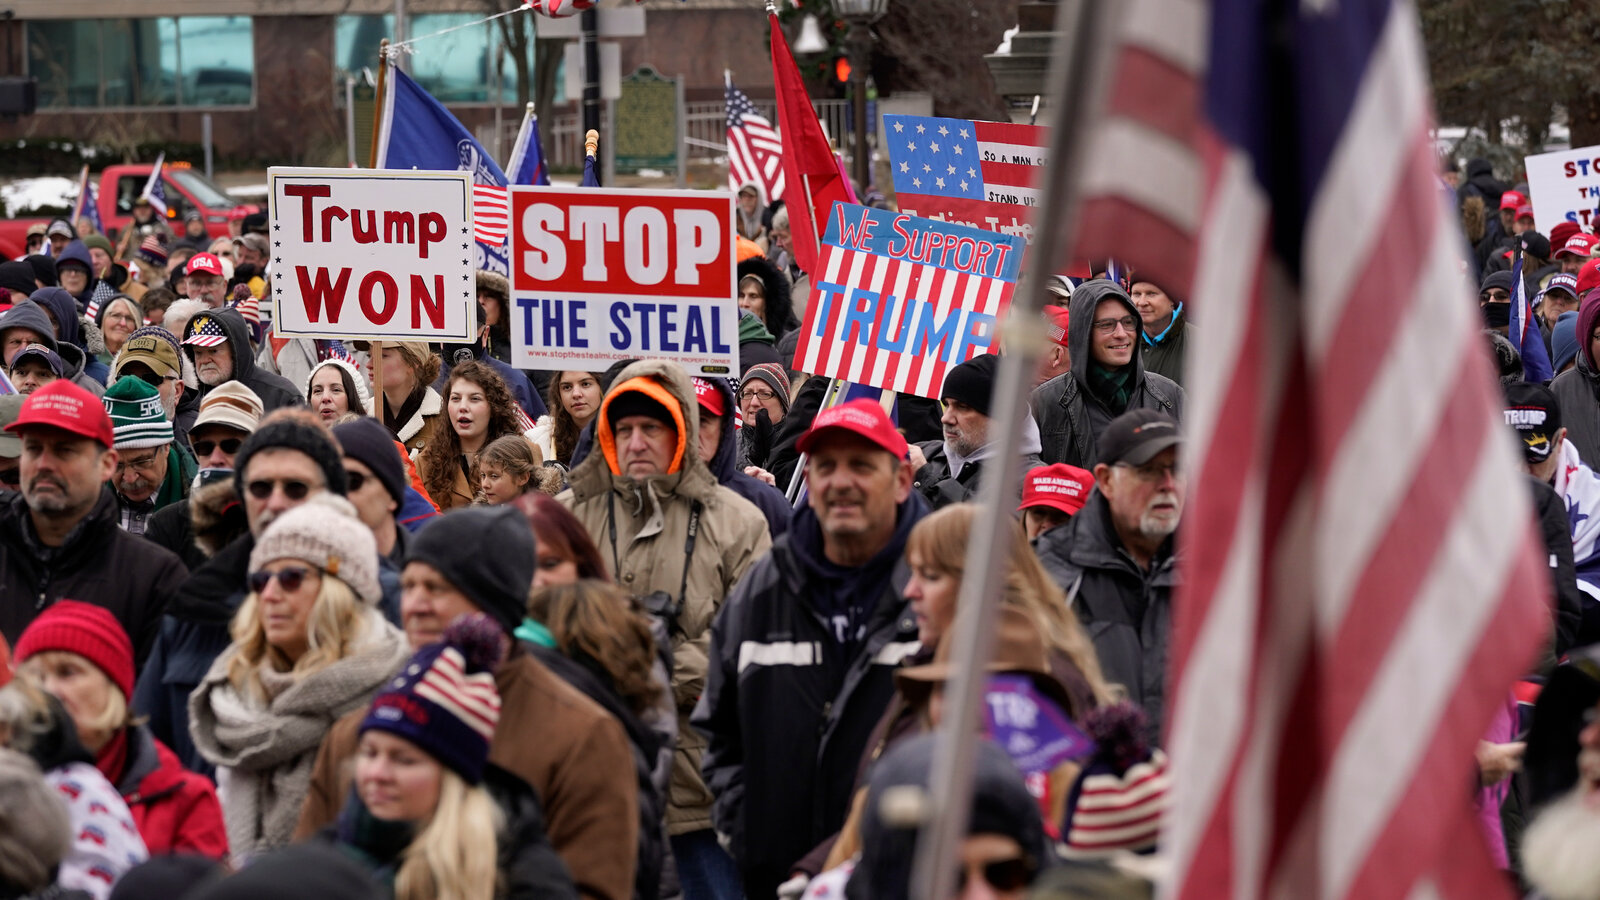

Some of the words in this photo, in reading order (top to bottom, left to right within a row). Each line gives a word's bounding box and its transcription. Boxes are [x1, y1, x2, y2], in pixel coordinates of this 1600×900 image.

[984, 150, 996, 161] SO
[1001, 155, 1008, 163] A
[1012, 155, 1031, 166] MAN
[988, 191, 1019, 205] STAND
[1023, 196, 1036, 208] UP
[284, 184, 447, 259] Trump
[522, 203, 721, 286] STOP
[836, 203, 879, 252] WE
[888, 214, 1013, 278] SUPPORT
[192, 256, 214, 269] USA
[295, 265, 445, 329] WON
[516, 298, 589, 348] THE
[609, 301, 731, 354] STEAL
[816, 280, 998, 365] TRUMP
[527, 350, 631, 361] www.stopthestealmi.com
[1503, 409, 1547, 425] TRUMP
[1052, 477, 1083, 490] AMERICA
[1056, 486, 1079, 496] AGAIN
